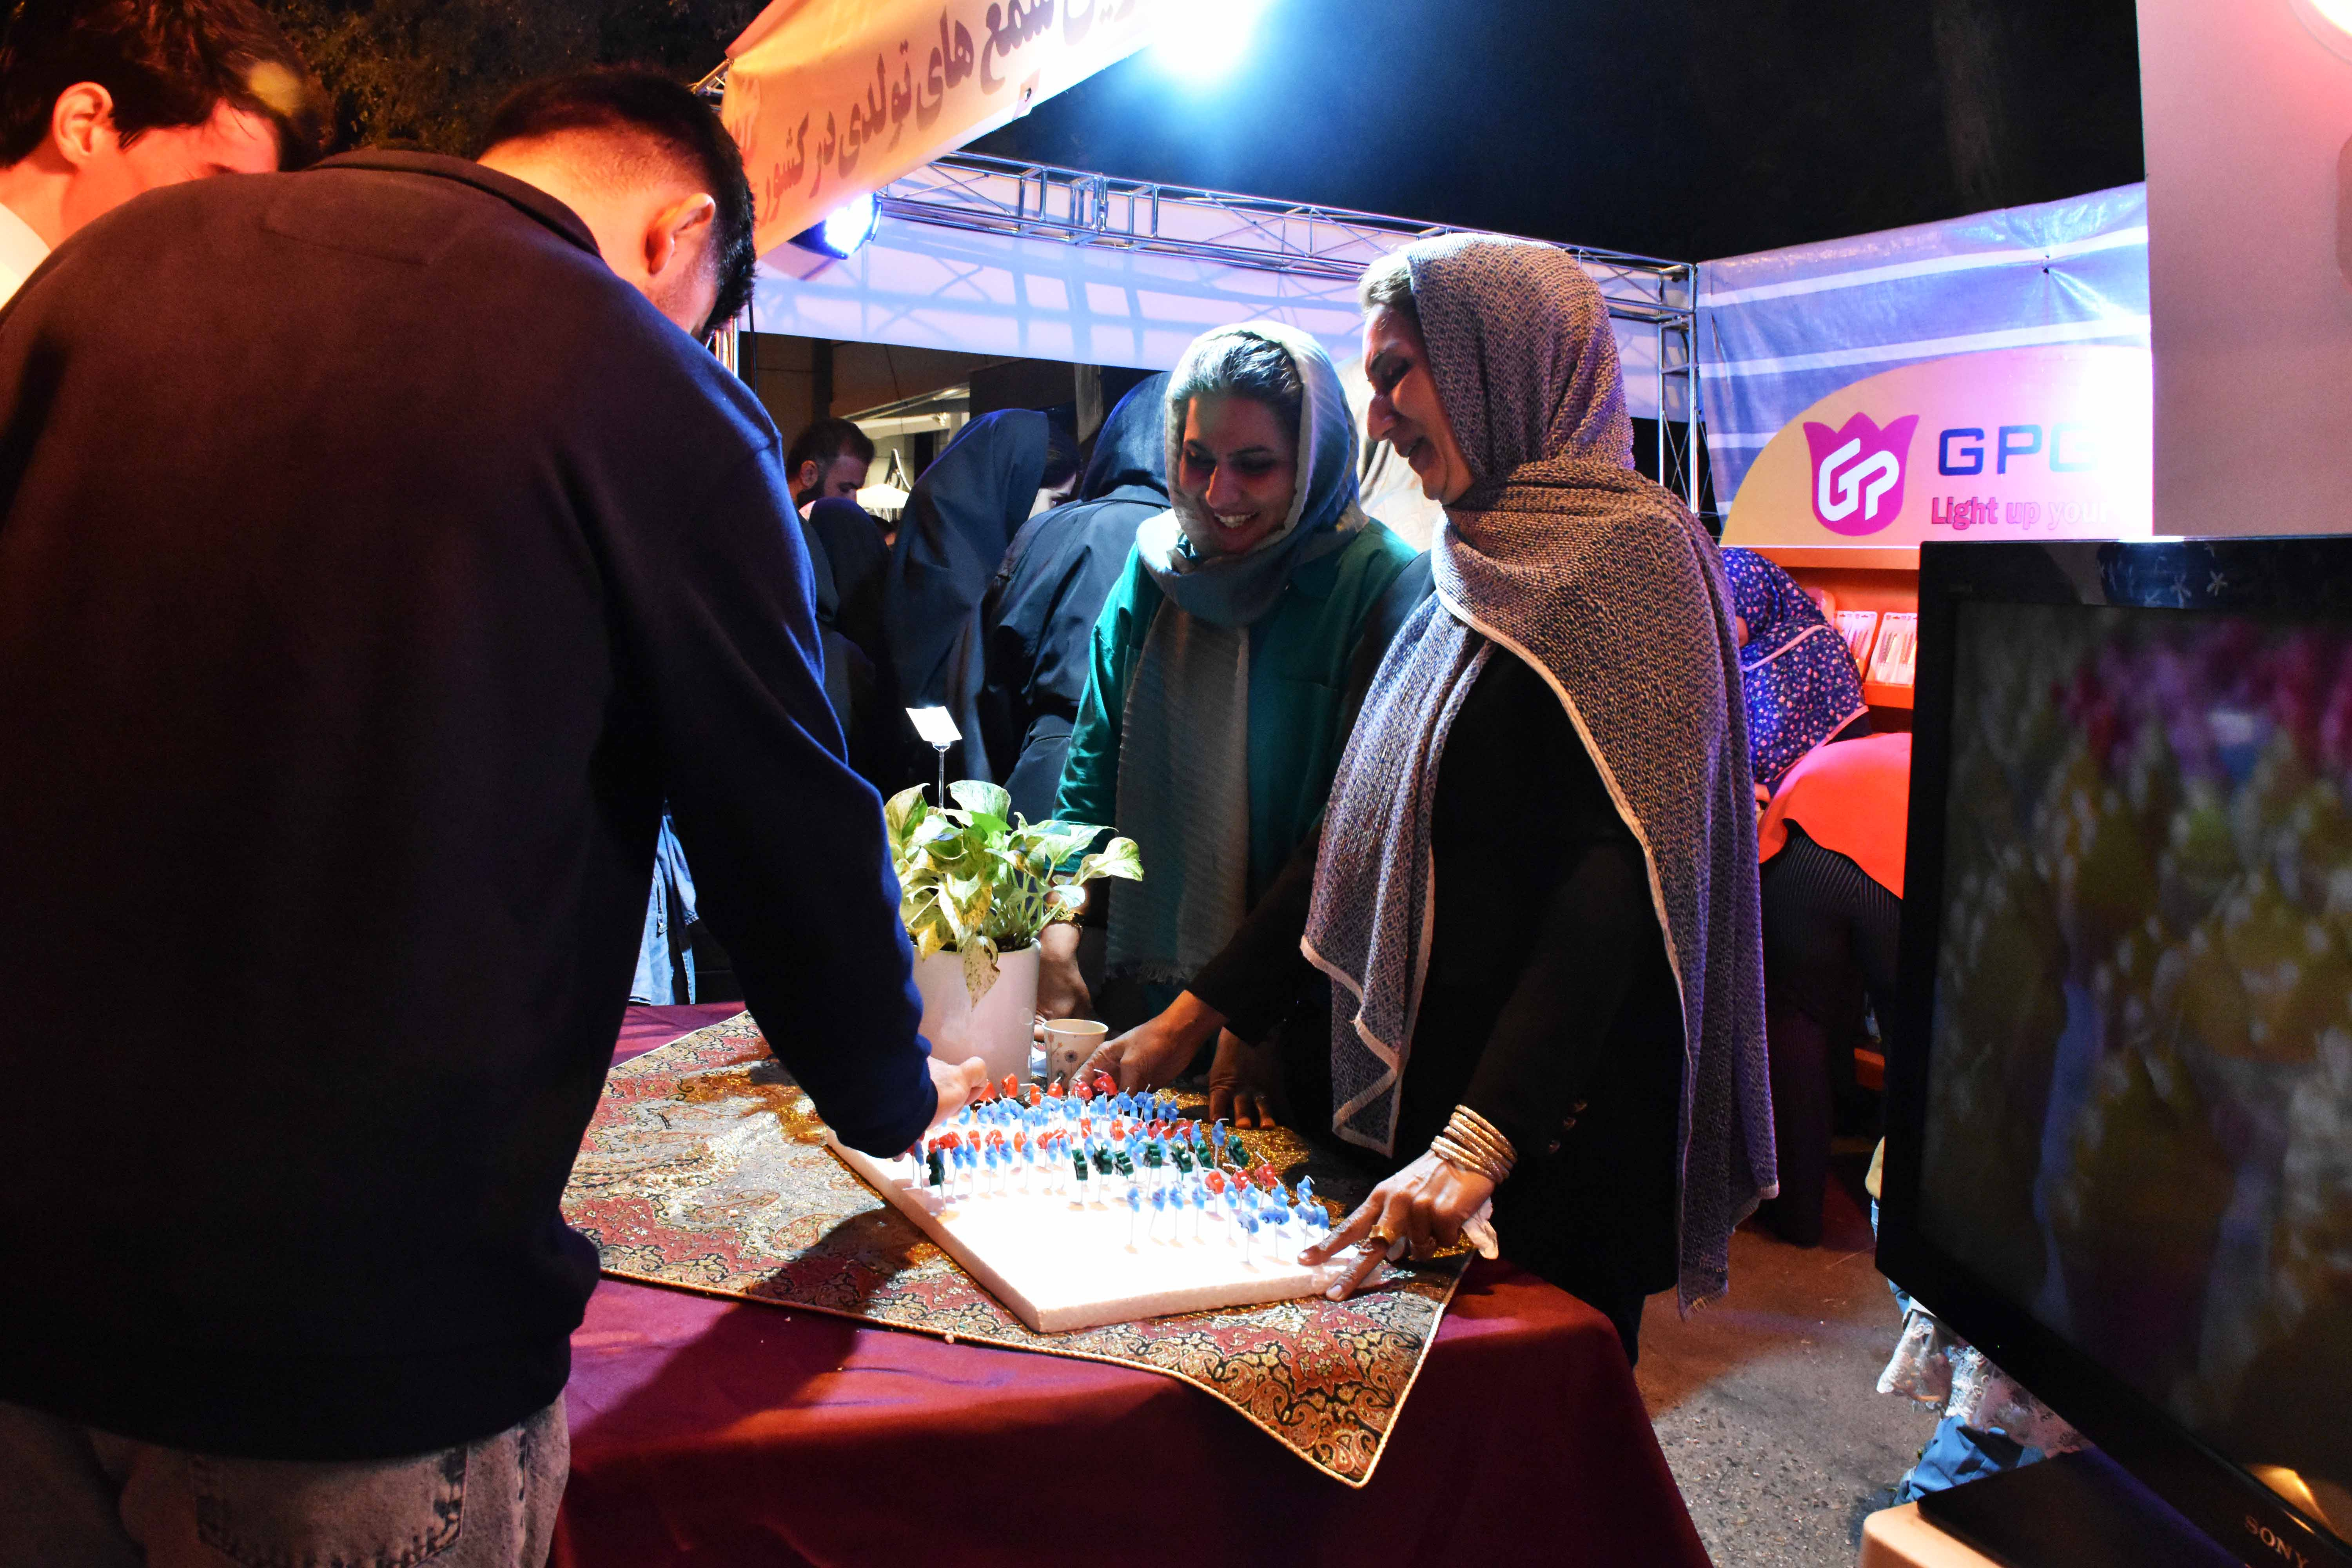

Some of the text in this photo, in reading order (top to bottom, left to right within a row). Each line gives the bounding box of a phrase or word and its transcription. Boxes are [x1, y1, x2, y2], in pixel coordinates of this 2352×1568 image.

[838, 39, 912, 179] تولدی
[916, 5, 974, 131] های
[757, 112, 809, 229] کشور
[809, 111, 836, 199] در
[1931, 496, 1999, 530] Light
[2006, 501, 2041, 530] up
[2245, 1514, 2308, 1568] SONY
